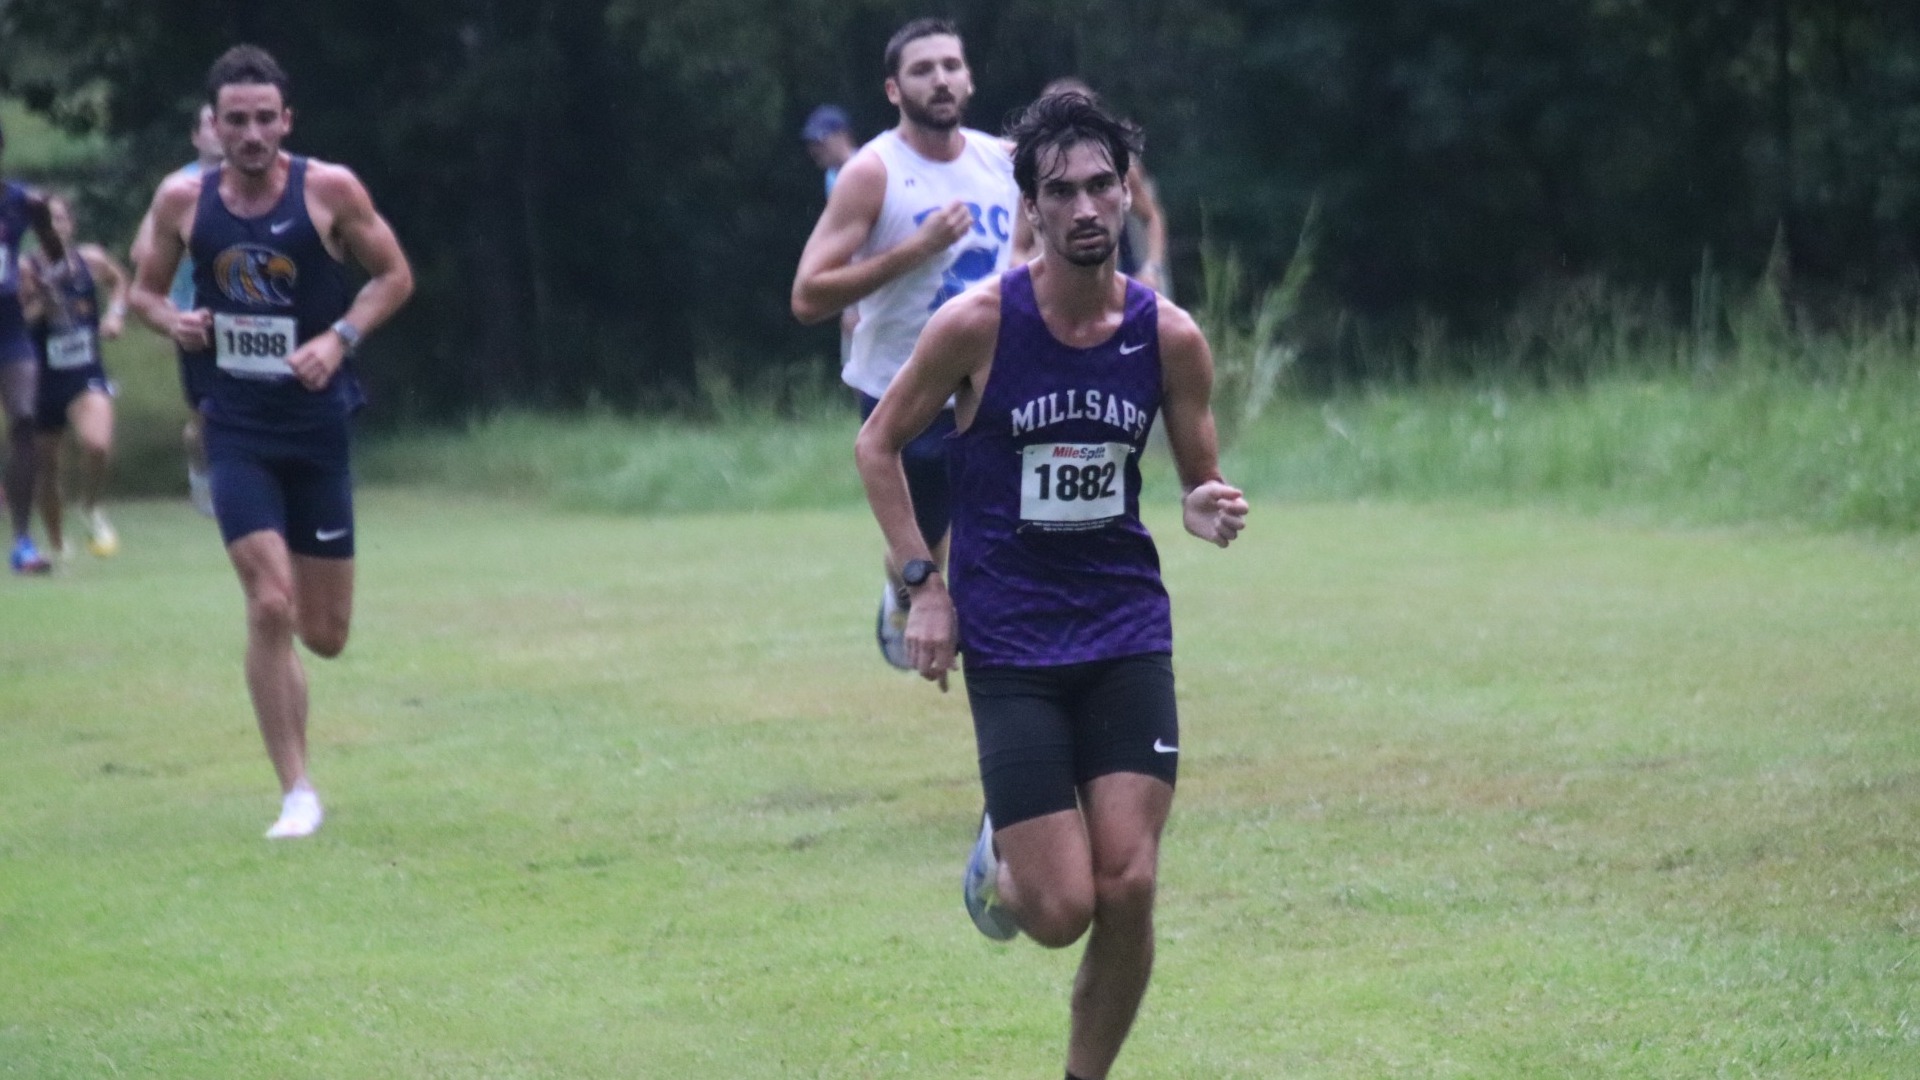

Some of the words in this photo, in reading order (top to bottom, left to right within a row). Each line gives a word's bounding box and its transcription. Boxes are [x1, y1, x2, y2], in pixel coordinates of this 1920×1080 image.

[223, 330, 288, 357] 1898
[1011, 389, 1148, 438] MILLSAPS
[1052, 446, 1106, 461] MileSplit
[1034, 461, 1116, 501] 1882
